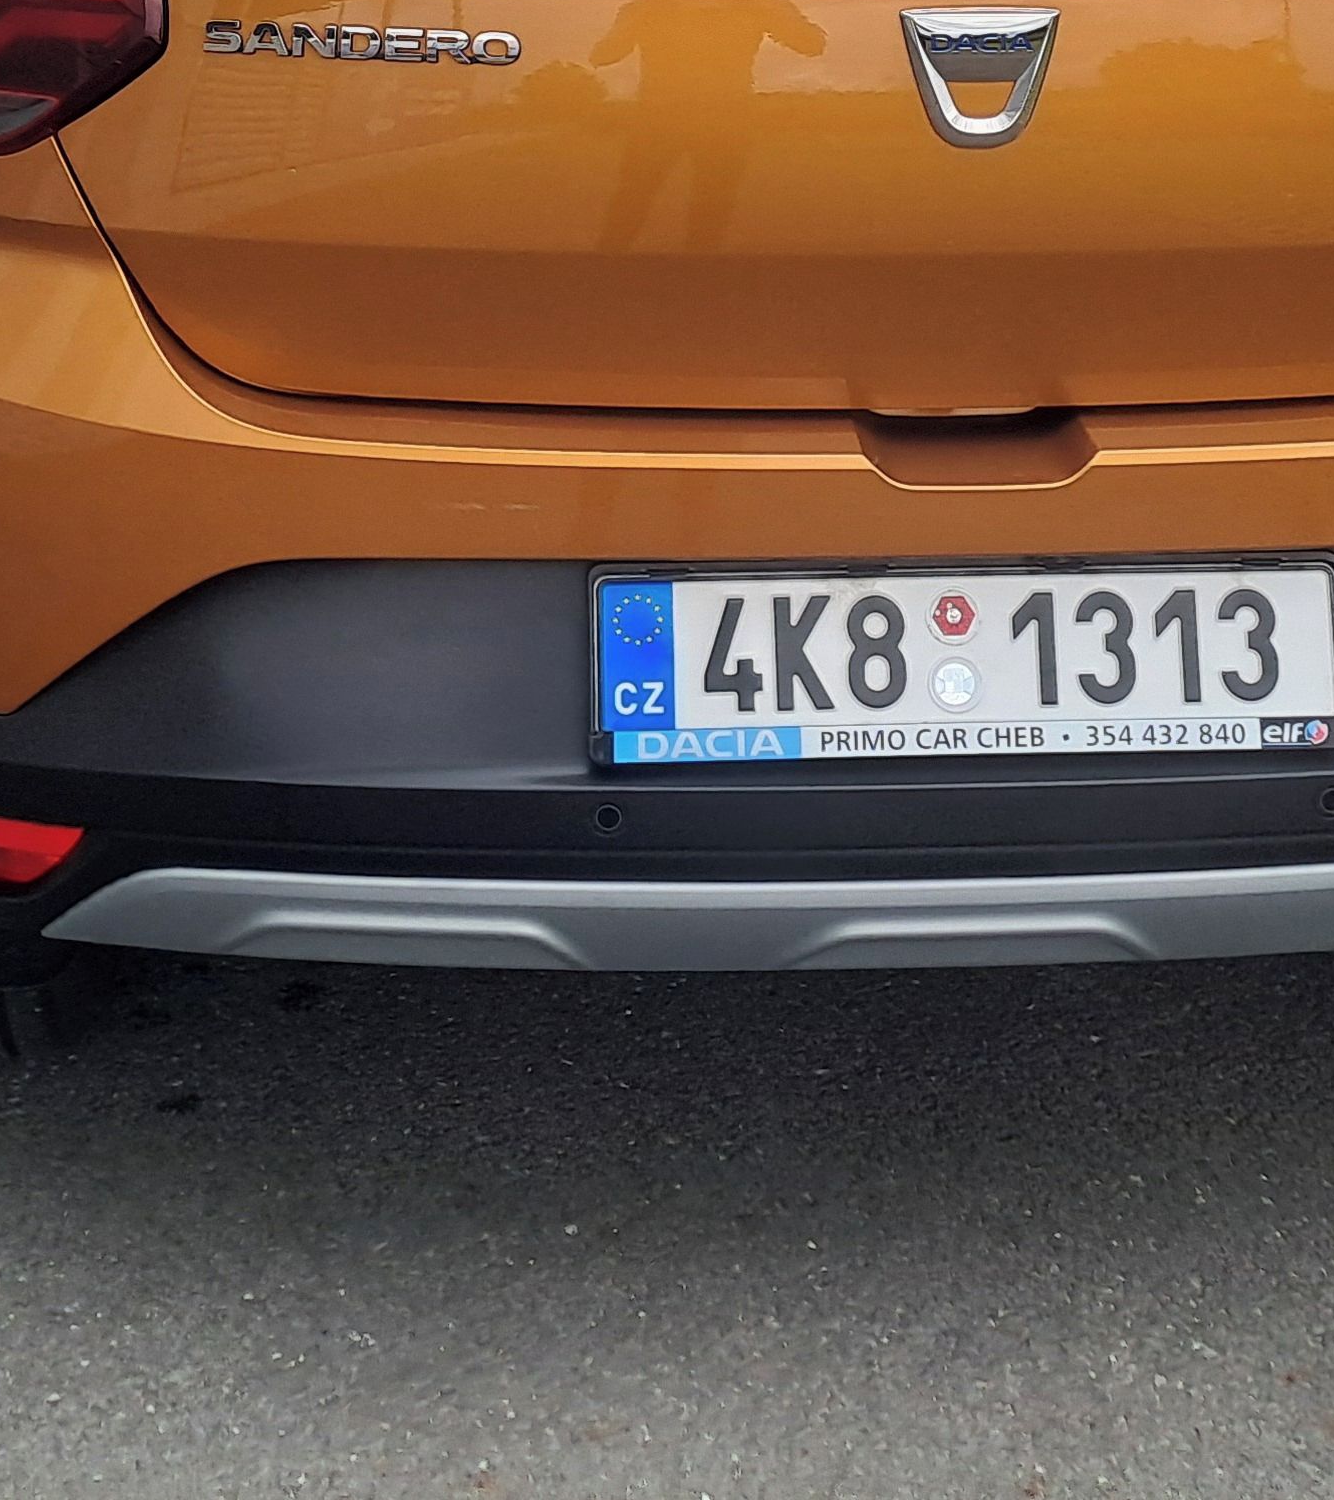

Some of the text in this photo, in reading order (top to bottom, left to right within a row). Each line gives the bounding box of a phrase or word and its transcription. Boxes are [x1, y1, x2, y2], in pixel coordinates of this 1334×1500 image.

[203, 19, 522, 66] SANDERO
[930, 32, 1035, 54] DACIA
[704, 588, 1280, 713] 4K8 1313
[613, 681, 666, 716] CZ
[636, 729, 785, 760] DACIA
[820, 722, 1246, 753] PRIMO CAR CHEB 354 432 840
[1262, 721, 1305, 743] elf
